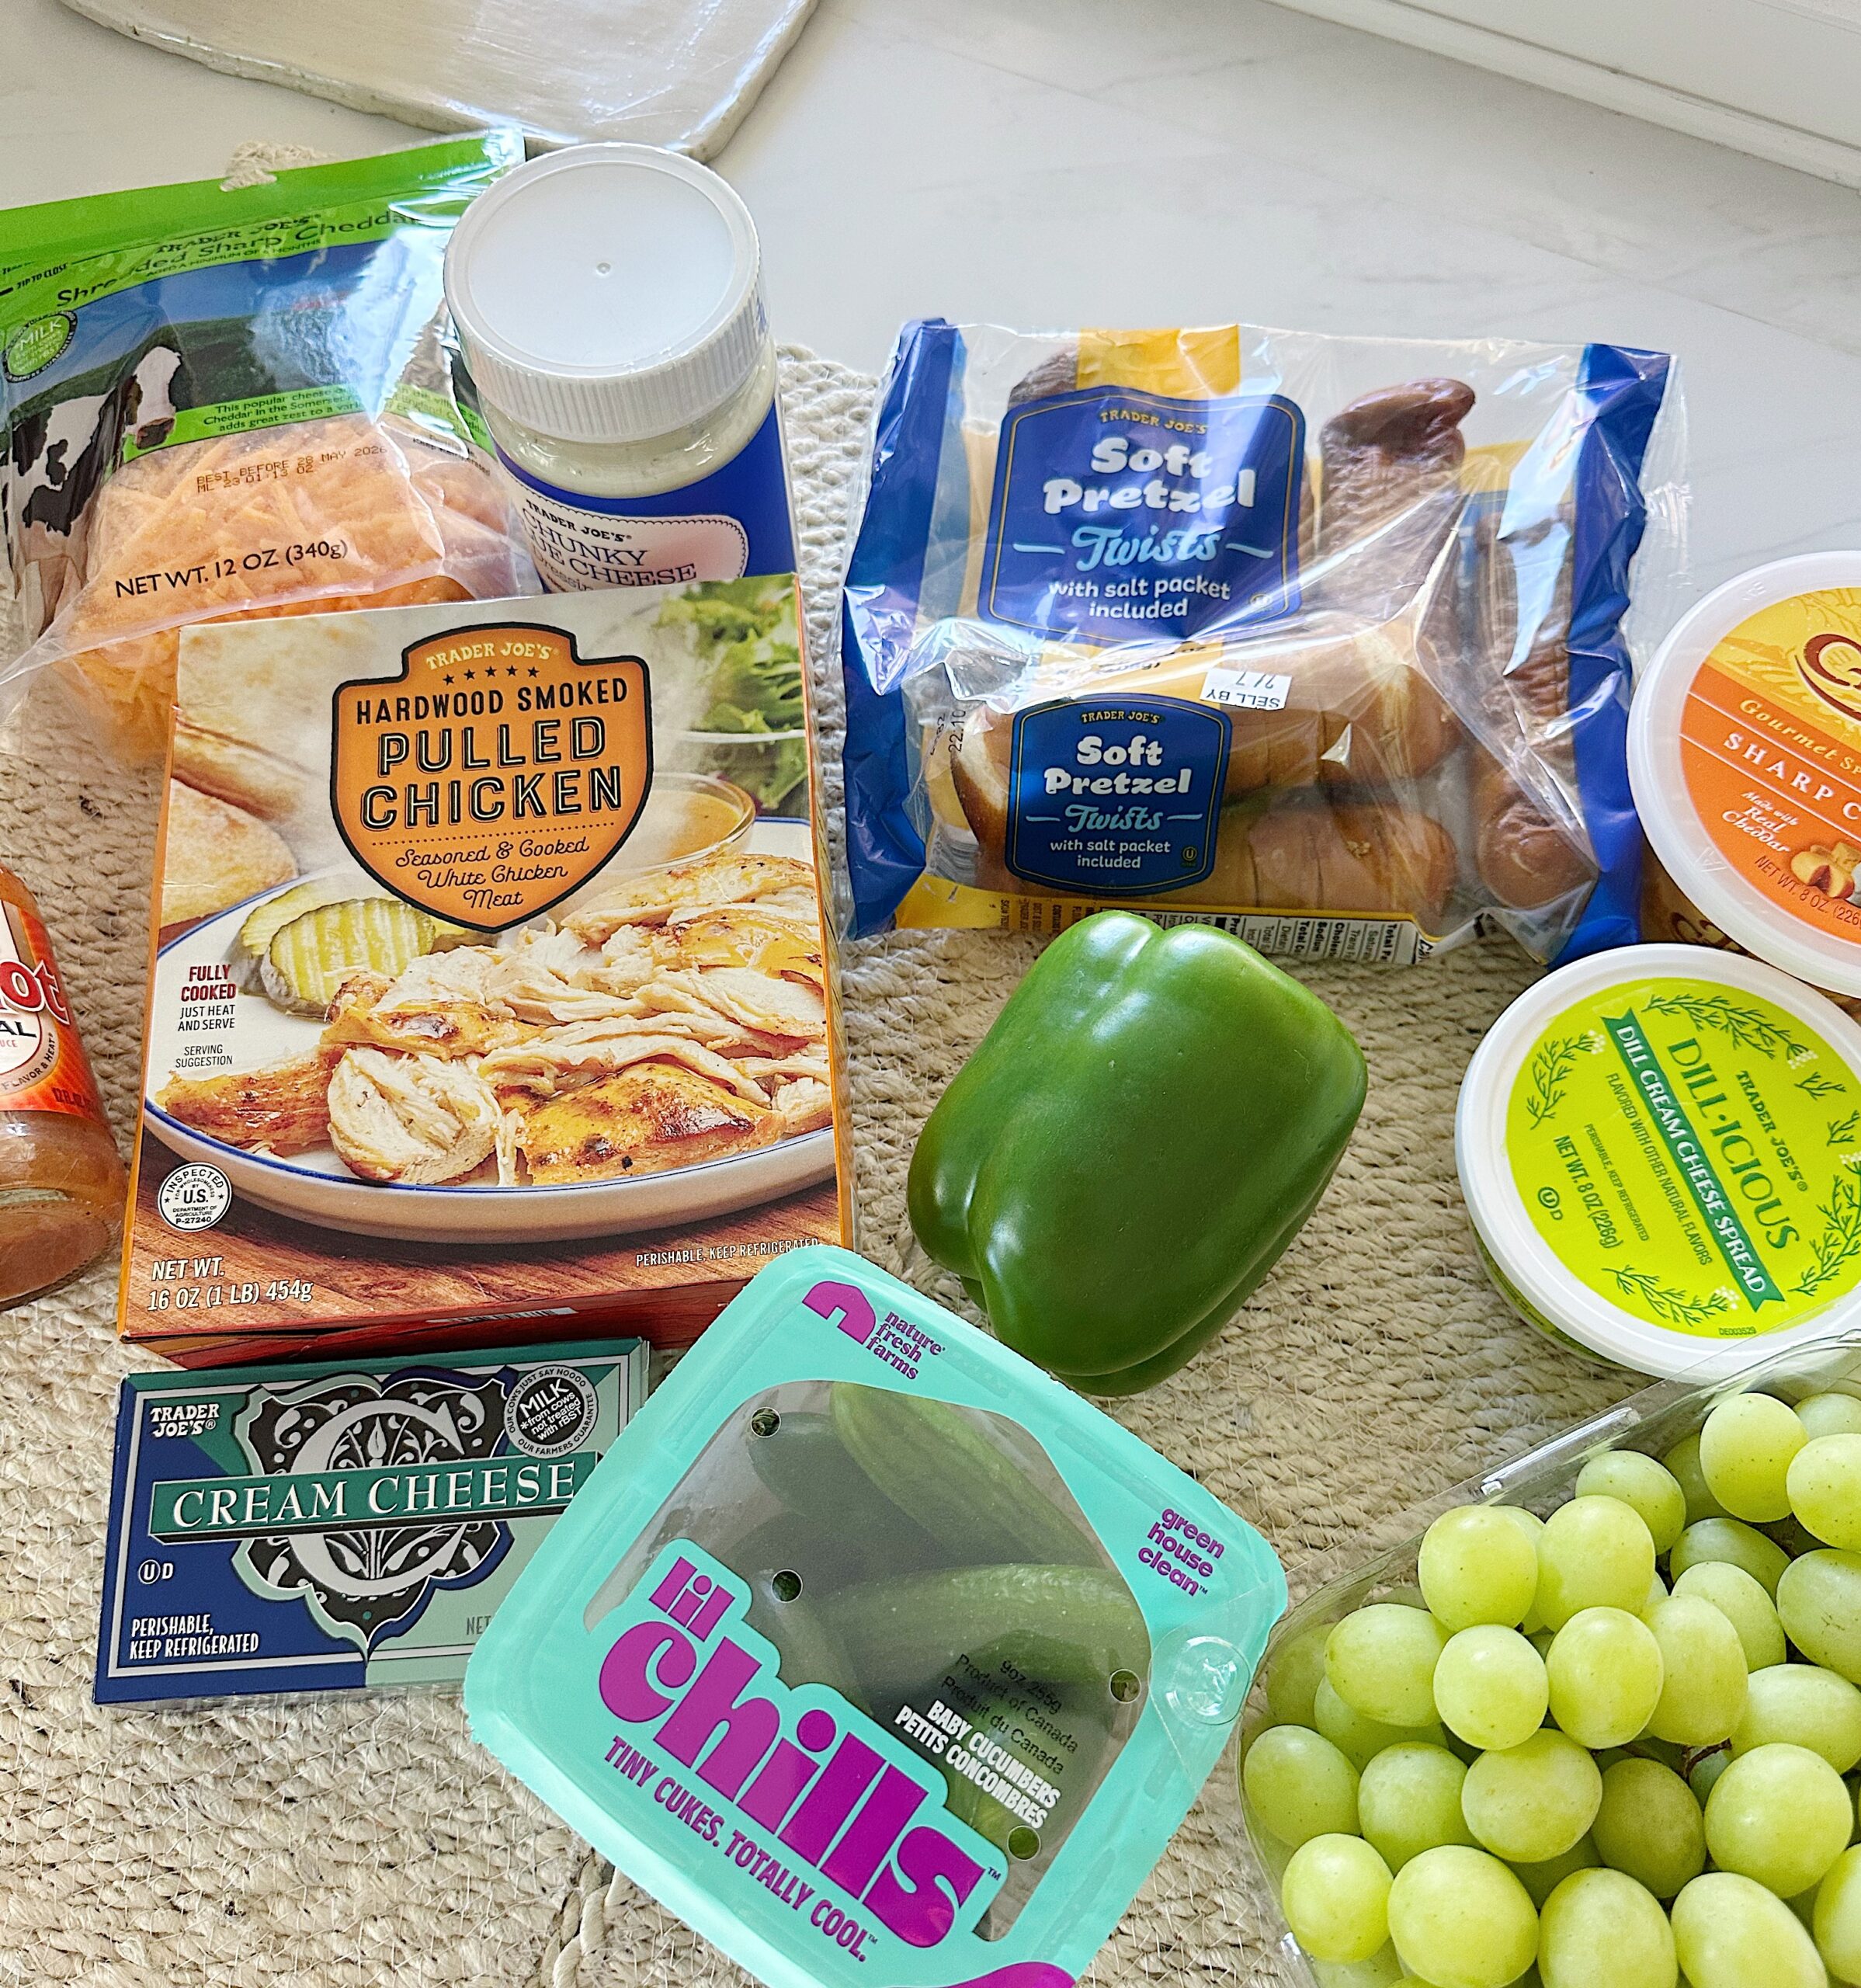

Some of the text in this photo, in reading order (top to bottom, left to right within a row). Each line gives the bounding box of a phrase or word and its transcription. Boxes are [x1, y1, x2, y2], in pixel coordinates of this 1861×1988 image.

[156, 231, 241, 254] TRADER
[57, 251, 187, 307] Shreded
[199, 235, 282, 257] Sharp
[20, 315, 62, 351] MILK
[203, 410, 252, 426] Cheddar
[269, 403, 288, 414] the
[215, 404, 240, 415] This
[244, 395, 287, 411] popular
[219, 415, 279, 433] adds great
[1099, 411, 1208, 435] TRADER JOE'S
[196, 470, 230, 485] BEST
[239, 459, 290, 477] BEFORE
[321, 450, 346, 463] MAY
[354, 445, 390, 457] 2026
[1091, 436, 1213, 478] Soft
[1043, 469, 1255, 515] Pretzel
[526, 499, 626, 542] TRADER JOE'S
[523, 507, 648, 566] CHUNKY
[1072, 524, 1223, 572] Twists
[115, 539, 349, 599] NET WT. 12 OZ (340g)
[570, 558, 697, 587] CHEESE
[1050, 579, 1099, 598] with
[1106, 578, 1149, 598] salt
[1154, 575, 1231, 603] packet
[1089, 598, 1189, 619] included
[425, 642, 553, 669] TRADER JOE'S
[357, 677, 627, 725] HARDWOOD SMOKED
[1206, 689, 1280, 708] SELL BY
[1081, 711, 1161, 724] TRADER JOE'S
[1739, 699, 1839, 761] Gourmet
[377, 715, 606, 778] PULLED
[1077, 736, 1163, 766] Soft
[1043, 768, 1193, 795] Pretzel
[1723, 732, 1834, 802] SHARP
[360, 765, 623, 832] CHICKEN
[1741, 791, 1799, 827] Made with
[1064, 805, 1164, 833] Twists
[1721, 809, 1790, 853] Cheddar
[1744, 805, 1786, 834] Real
[396, 836, 590, 867] Seasoned & Cooked
[1050, 839, 1171, 855] with salt packet
[1077, 854, 1141, 869] included
[417, 864, 568, 889] White Chicken
[1755, 855, 1828, 914] NET WT. 8 OZ.
[463, 888, 524, 909] Meat
[189, 964, 231, 982] FULLY
[181, 983, 237, 1002] COOKED
[178, 1018, 235, 1032] AND SERVE
[180, 1004, 236, 1019] JUST HEAT
[175, 1055, 233, 1069] SUGGESTION
[184, 1044, 224, 1056] SERVING
[1735, 1070, 1804, 1183] TRADER JOE'S
[1606, 1072, 1713, 1266] FLAVORED WITH OTHER NATURAL FLAVORS
[1616, 1025, 1769, 1293] DILL CREAM CHEESE SPREAD
[166, 1169, 224, 1193] INSPECTED
[183, 1189, 209, 1204] U.S.
[1554, 1135, 1624, 1249] NET WT. 8 OZ (226g)
[1584, 1123, 1650, 1242] PERISHABLE, KEEP REFRIGERATED
[175, 1216, 211, 1225] P-27240
[151, 1256, 225, 1281] NET WT.
[636, 1247, 707, 1267] PERISHABLE,
[709, 1244, 737, 1261] KEEP
[148, 1279, 314, 1311] 16 OZ (1 LB) 454g
[875, 1322, 922, 1363] fresh
[884, 1312, 942, 1356] nature
[538, 1368, 555, 1378] SAY
[866, 1336, 919, 1380] farms
[519, 1374, 537, 1391] JUST
[150, 1403, 220, 1423] TRADER
[507, 1388, 522, 1414] COWS
[519, 1378, 571, 1419] MILK
[550, 1392, 575, 1411] cows
[152, 1419, 206, 1438] JOE'S
[506, 1415, 516, 1434] OUR
[518, 1392, 595, 1455] OUR FARMERS GUARANTEE
[531, 1397, 582, 1435] not treated
[537, 1406, 582, 1441] with rBST
[172, 1458, 579, 1528] CREAM CHEESE
[1147, 1521, 1213, 1577] house
[1161, 1508, 1225, 1559] green
[1138, 1547, 1200, 1597] clean
[648, 1555, 735, 1643] lil
[131, 1614, 215, 1638] PERISHABLE,
[466, 1615, 491, 1635] NET
[129, 1632, 259, 1660] KEEP REFRIGERATED
[1000, 1659, 1027, 1685] 9oz
[954, 1653, 1079, 1755] Product of Canada
[940, 1674, 1065, 1775] Produit du Canada
[894, 1705, 1049, 1830] PETITS CONCOMBRES
[926, 1698, 1062, 1809] BABY CUCUMBERS
[598, 1620, 987, 1949] chills
[604, 1735, 868, 1962] TINY CUKES. TOTALLY COOL.
